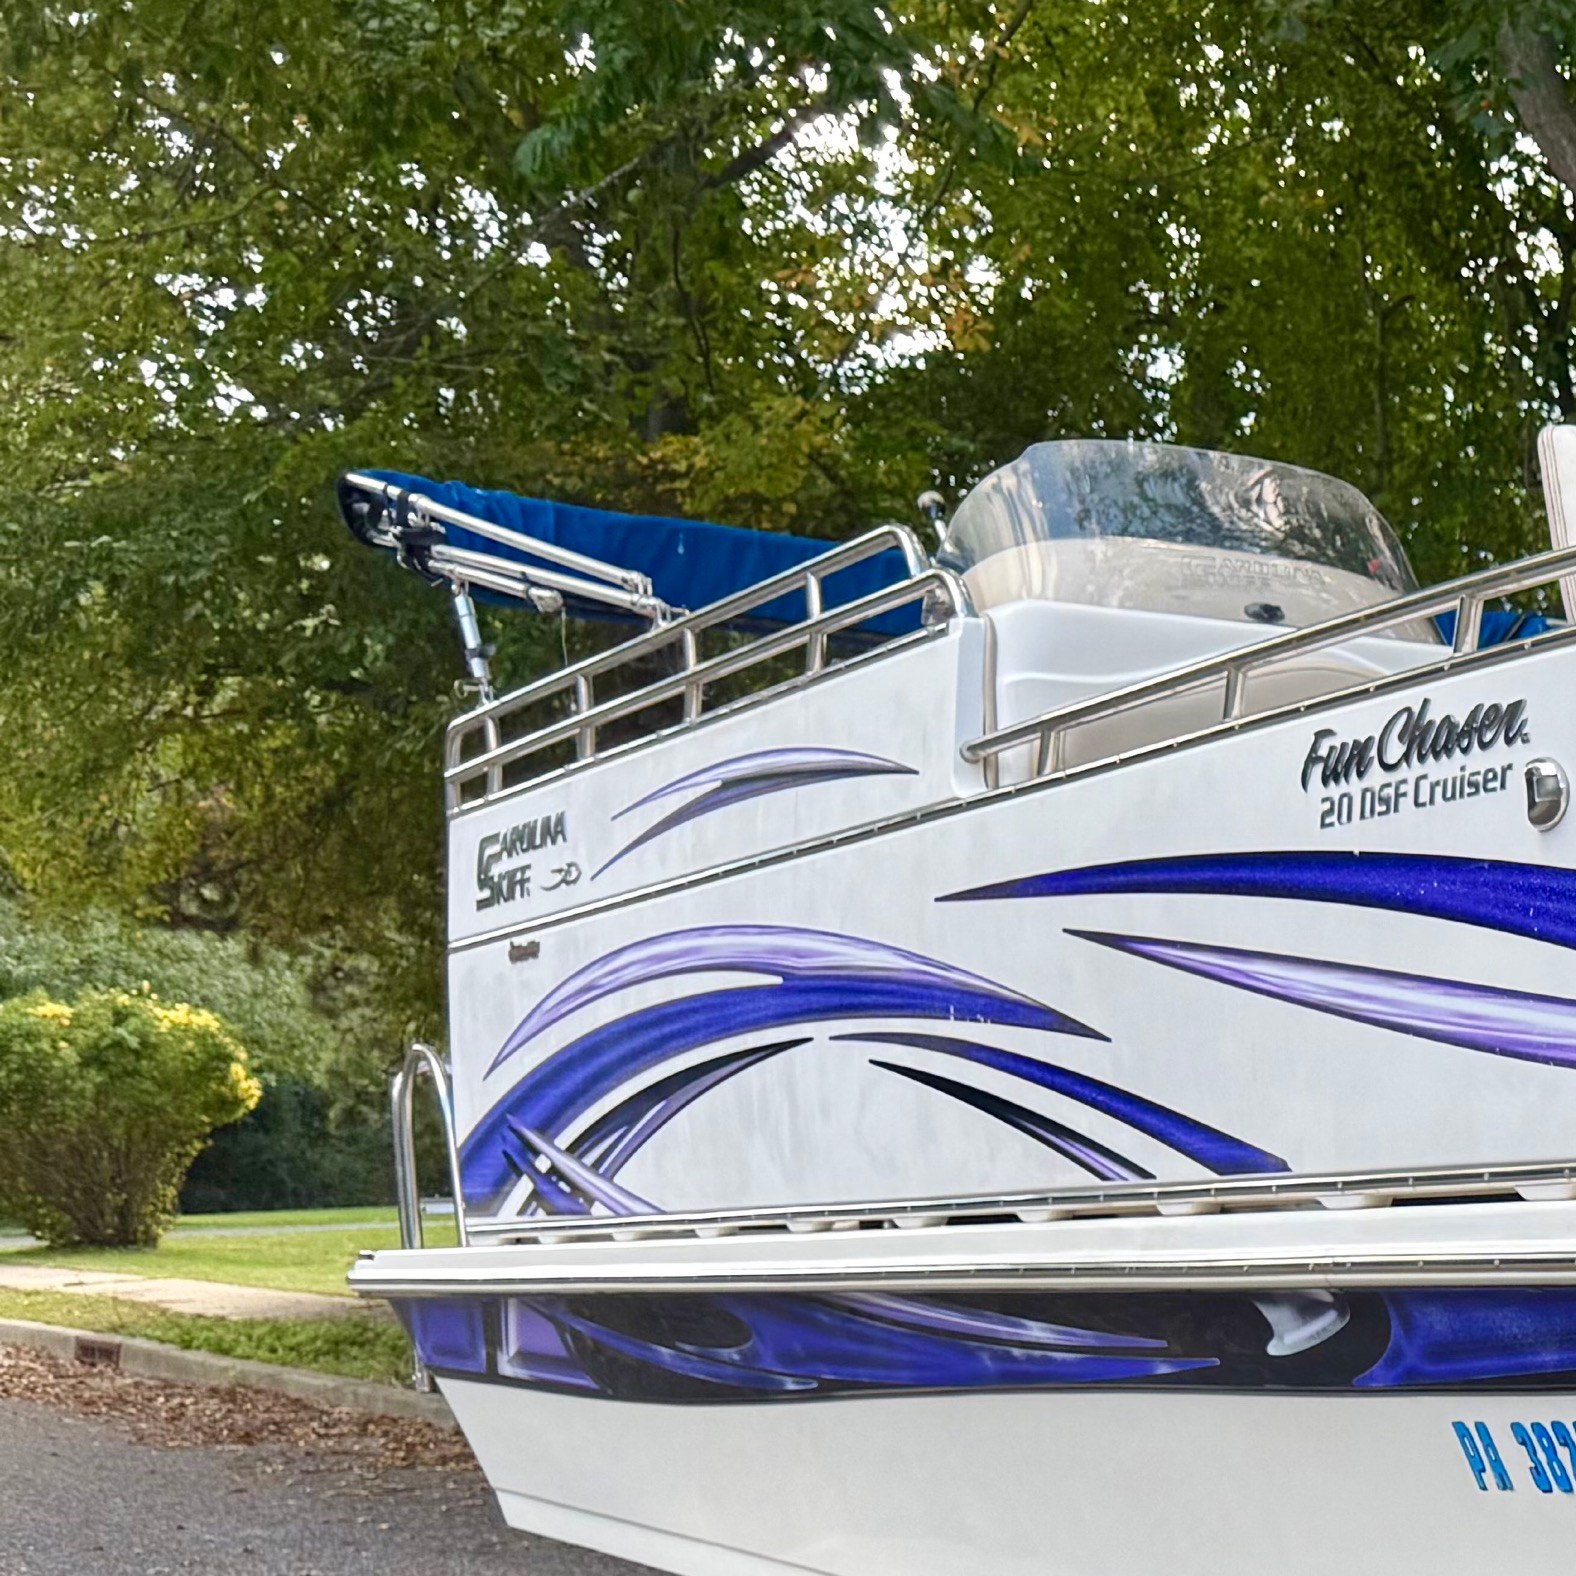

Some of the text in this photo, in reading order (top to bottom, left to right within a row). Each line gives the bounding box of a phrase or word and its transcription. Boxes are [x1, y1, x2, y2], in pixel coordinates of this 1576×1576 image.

[1301, 697, 1529, 793] Fun Chaser
[1319, 791, 1353, 830] 20
[1413, 761, 1514, 808] Cruiser
[477, 810, 567, 866] CAROLINA
[1451, 1420, 1514, 1491] PA
